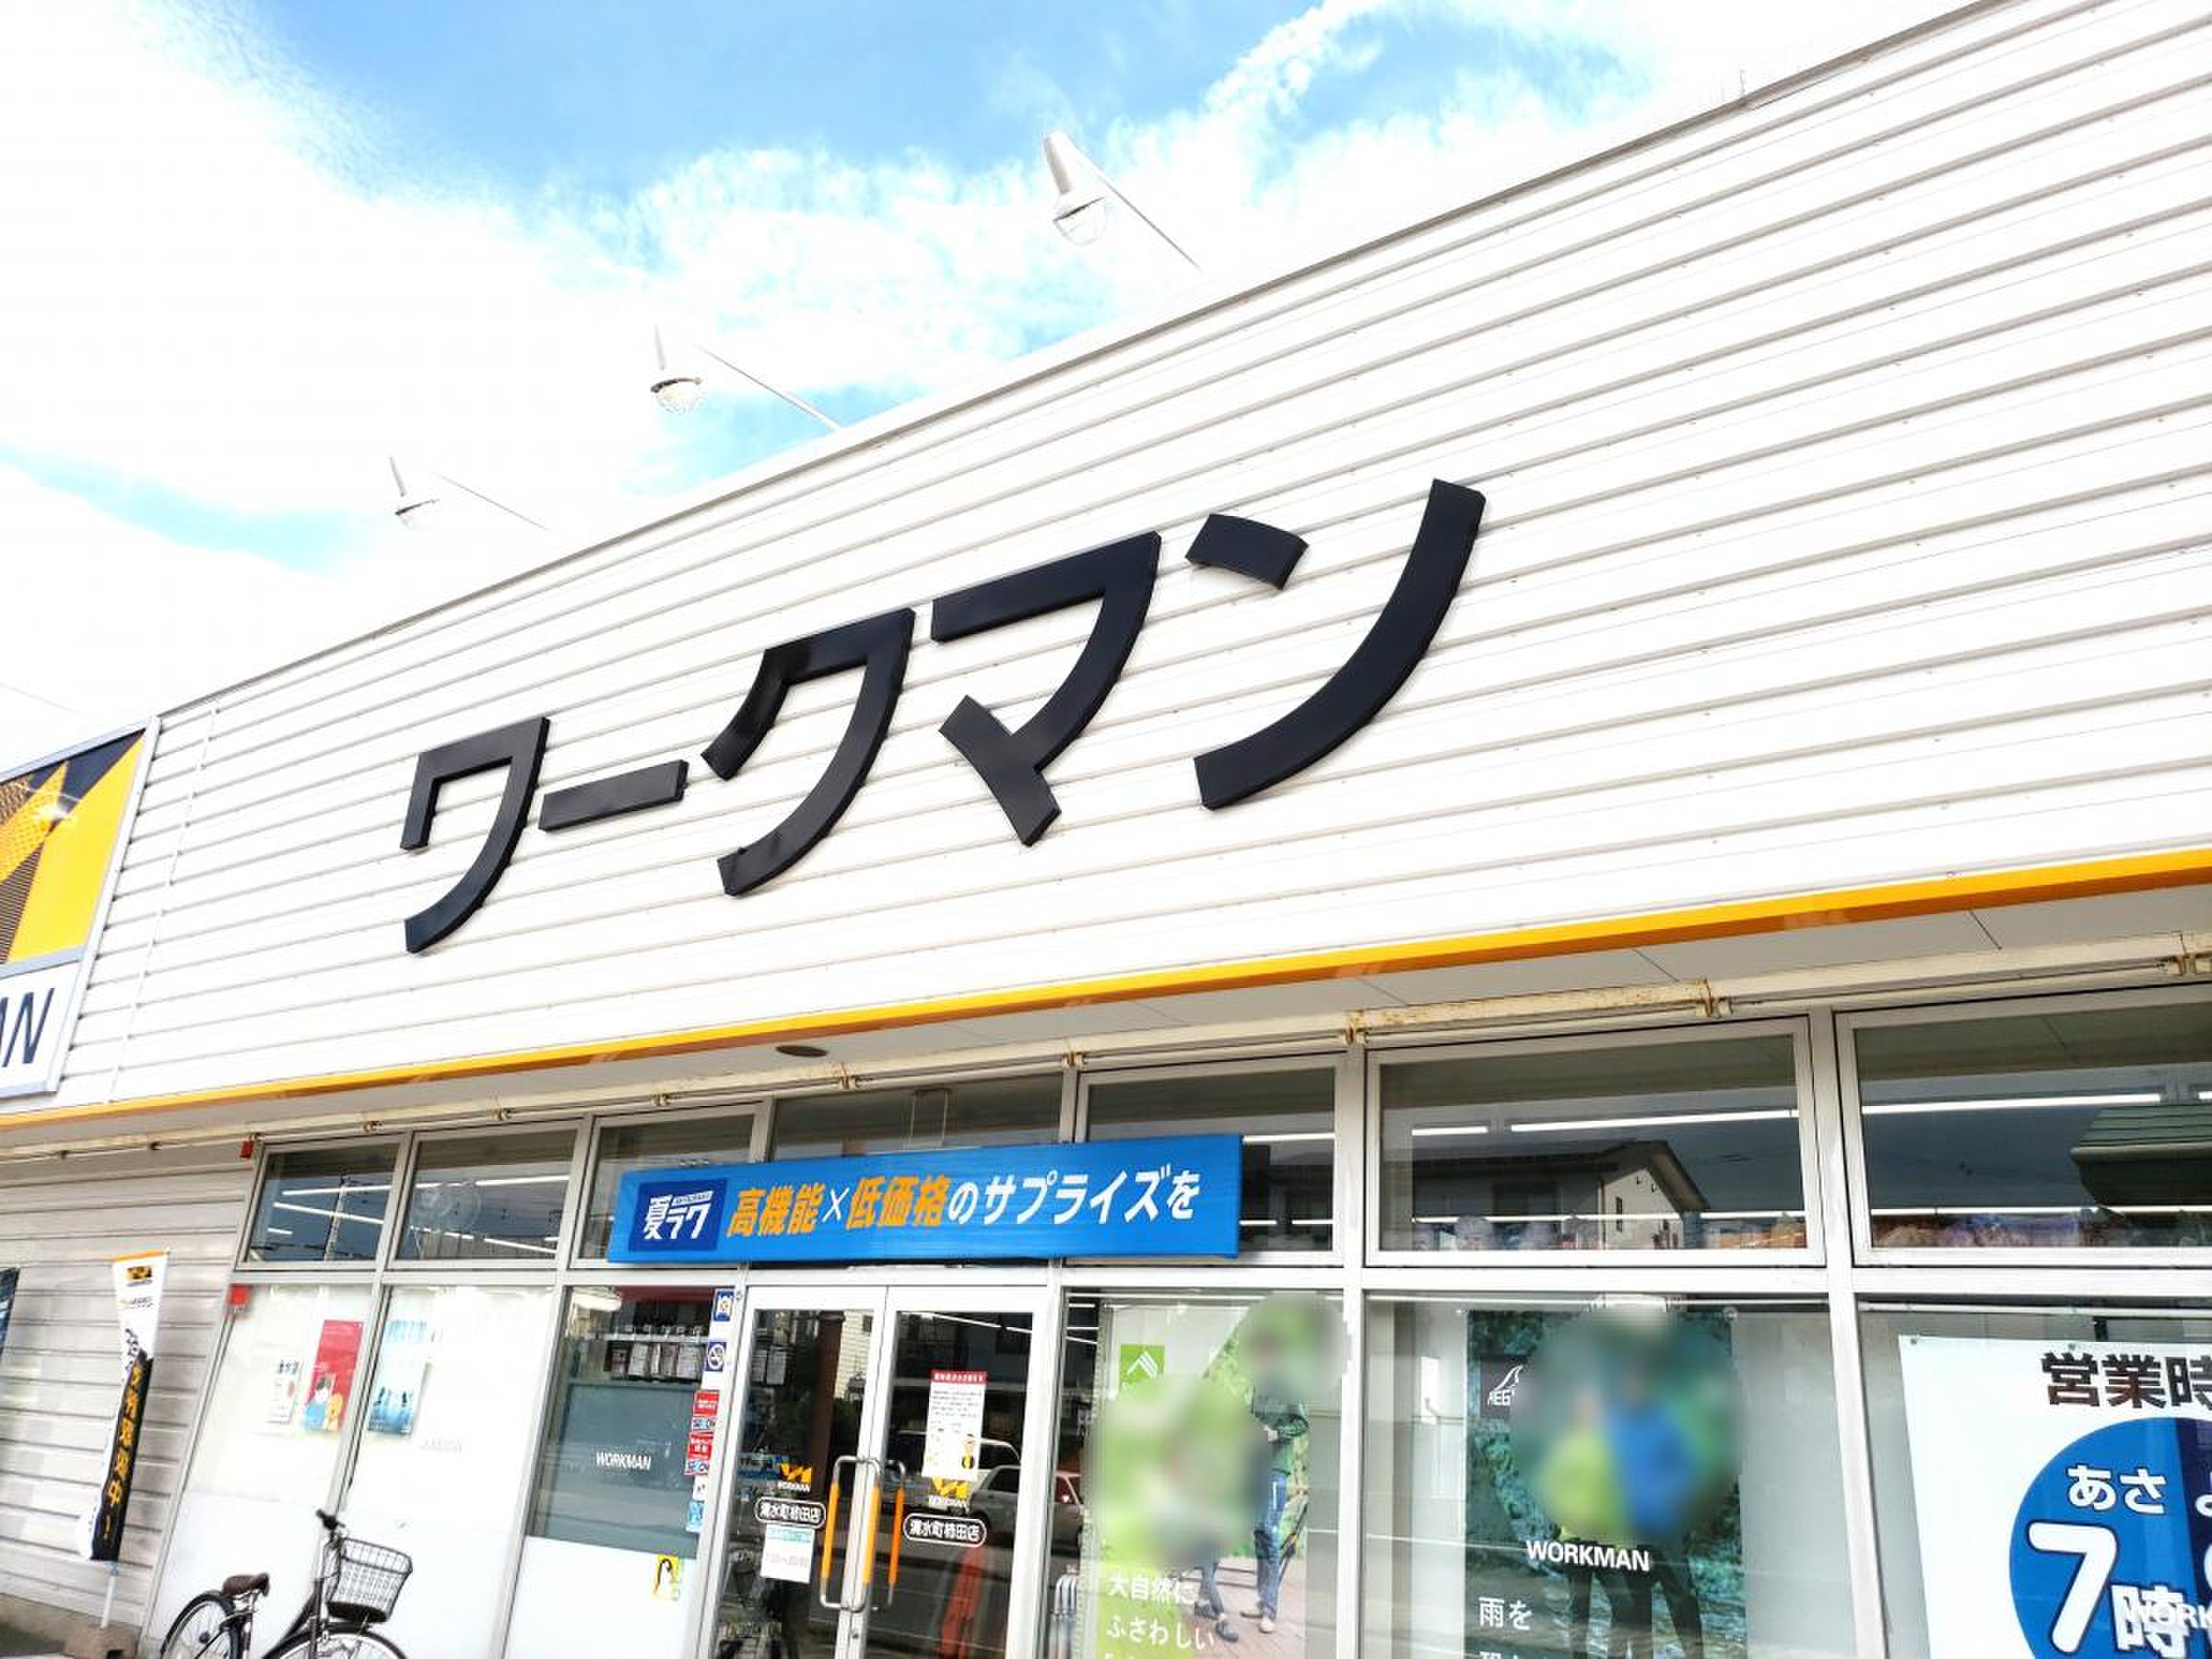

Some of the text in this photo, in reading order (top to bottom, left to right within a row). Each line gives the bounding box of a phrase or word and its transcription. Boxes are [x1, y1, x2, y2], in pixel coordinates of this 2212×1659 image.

[400, 477, 1487, 954] ワークマン
[2066, 1463, 2168, 1516] あさ
[1525, 1539, 1650, 1572] WORKMAN
[1108, 1571, 1200, 1606] 大自然に
[1477, 1595, 1534, 1631] 雨を
[1105, 1615, 1215, 1651] ふさわしい
